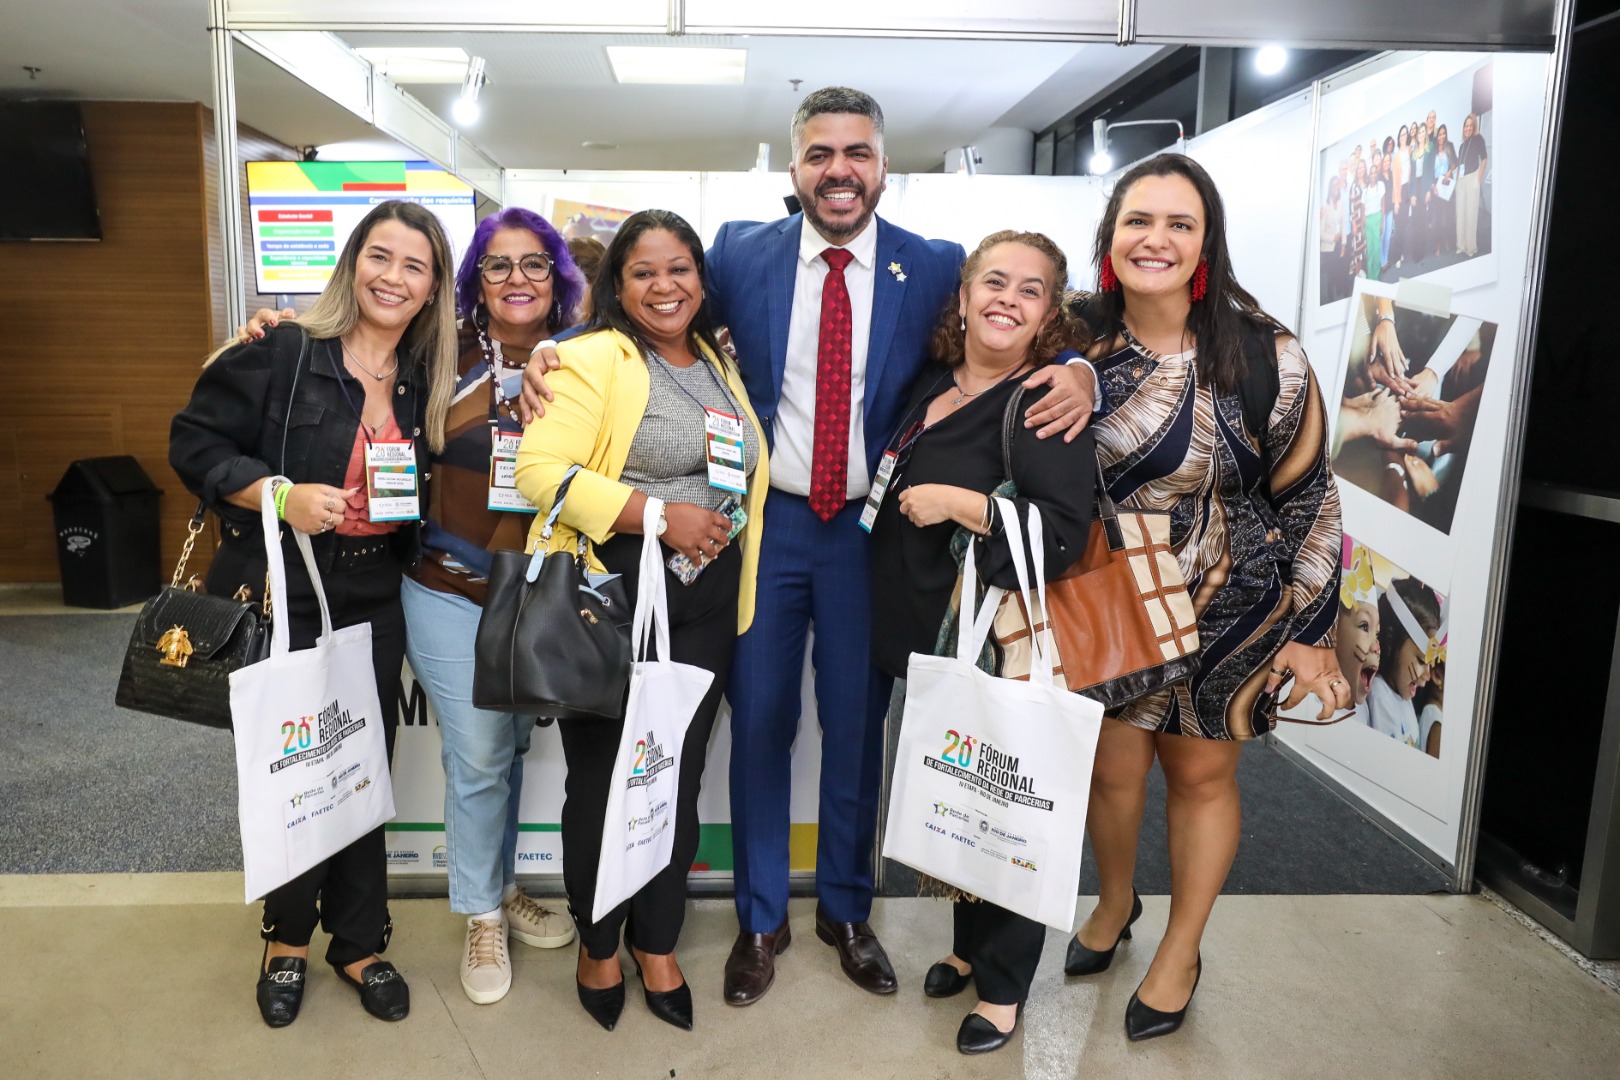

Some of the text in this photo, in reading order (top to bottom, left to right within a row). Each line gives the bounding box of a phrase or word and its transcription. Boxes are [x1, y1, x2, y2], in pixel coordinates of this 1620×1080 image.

[435, 196, 471, 205] requisitos
[318, 699, 340, 728] FÓRUM
[319, 709, 353, 744] REGIONAL
[272, 762, 280, 772] DE
[280, 744, 327, 770] FORTALECIMENTO
[634, 740, 646, 774] 2
[980, 742, 1020, 773] FÓRUM
[926, 758, 1050, 810] DE FORTALECIMENTO DA REDE DE PARCERIAS
[964, 782, 977, 793] ETAPA
[976, 758, 1036, 794] REGIONAL
[287, 804, 334, 828] CAIXA FAETEC
[925, 822, 946, 836] CAIXA
[951, 832, 976, 848] FAETEC
[518, 852, 552, 860] FAETEC
